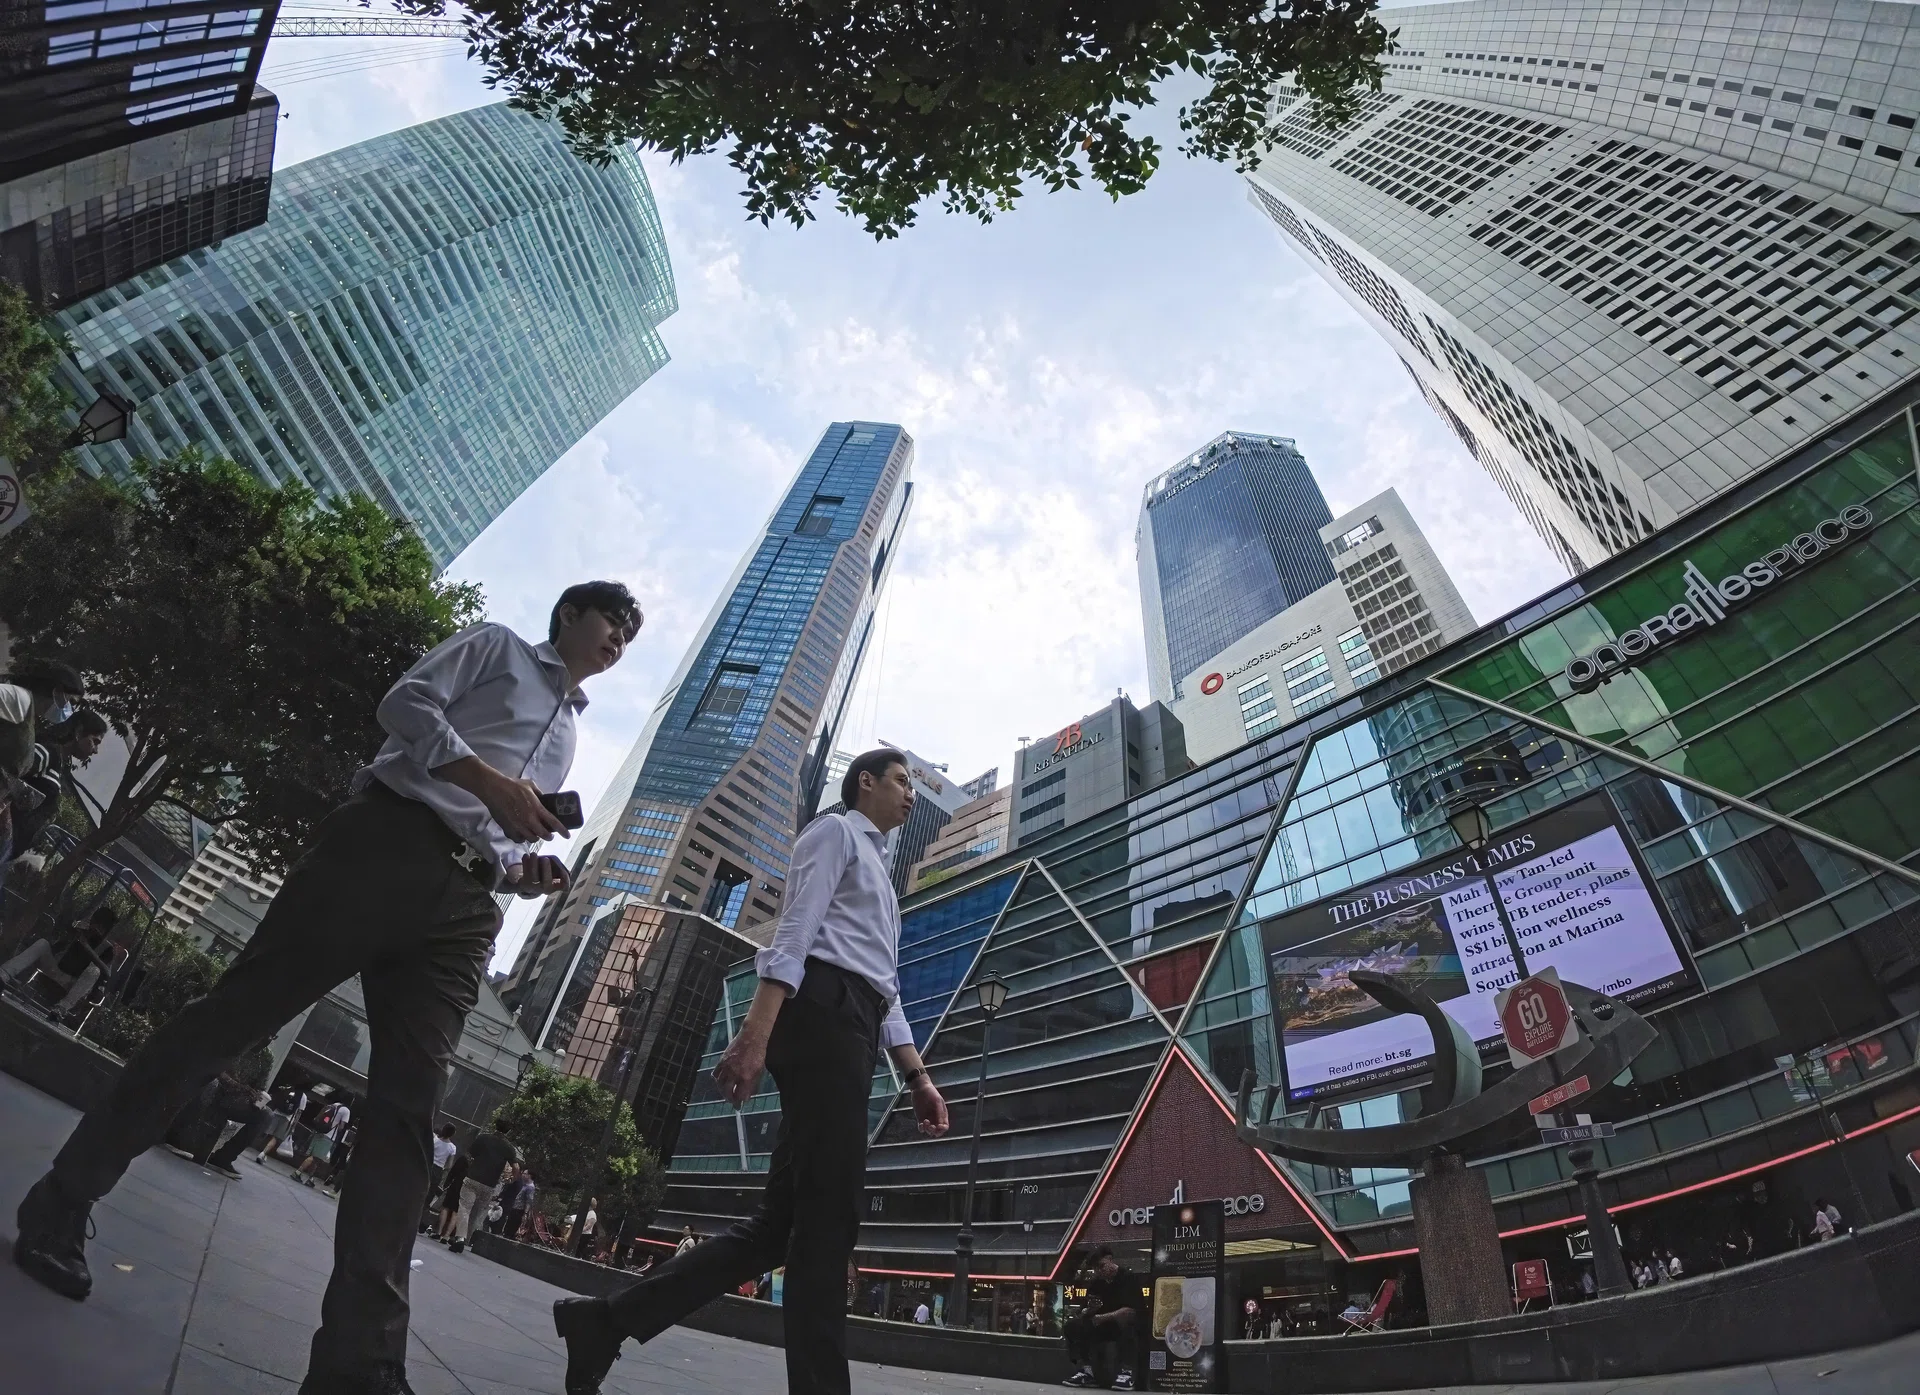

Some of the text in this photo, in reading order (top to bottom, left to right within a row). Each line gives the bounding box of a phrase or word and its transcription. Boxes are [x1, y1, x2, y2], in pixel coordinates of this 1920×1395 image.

[1051, 732, 1105, 764] CAPITAL
[1328, 897, 1371, 924] THE
[1372, 862, 1465, 911] BUSINESS
[1448, 888, 1481, 907] Mah
[1516, 849, 1575, 880] Tan-led
[1514, 876, 1562, 900] Group
[1565, 860, 1597, 881] unit
[1460, 917, 1495, 940] wins
[1531, 887, 1587, 914] tender,
[1588, 867, 1631, 894] plans
[1464, 896, 1612, 958] S$1 biion wellness
[1471, 912, 1625, 975] attracion at Marina
[1475, 970, 1521, 994] South
[1657, 980, 1674, 991] says
[1517, 993, 1548, 1030] GO
[1524, 1020, 1554, 1041] EXPLORE
[1328, 1048, 1412, 1076] Read more: bt.sg
[1366, 1073, 1377, 1081] FBI
[1573, 1129, 1590, 1138] WALK
[1174, 1225, 1200, 1238] LPM
[1187, 1242, 1196, 1250] OF
[1198, 1241, 1217, 1249] LONG
